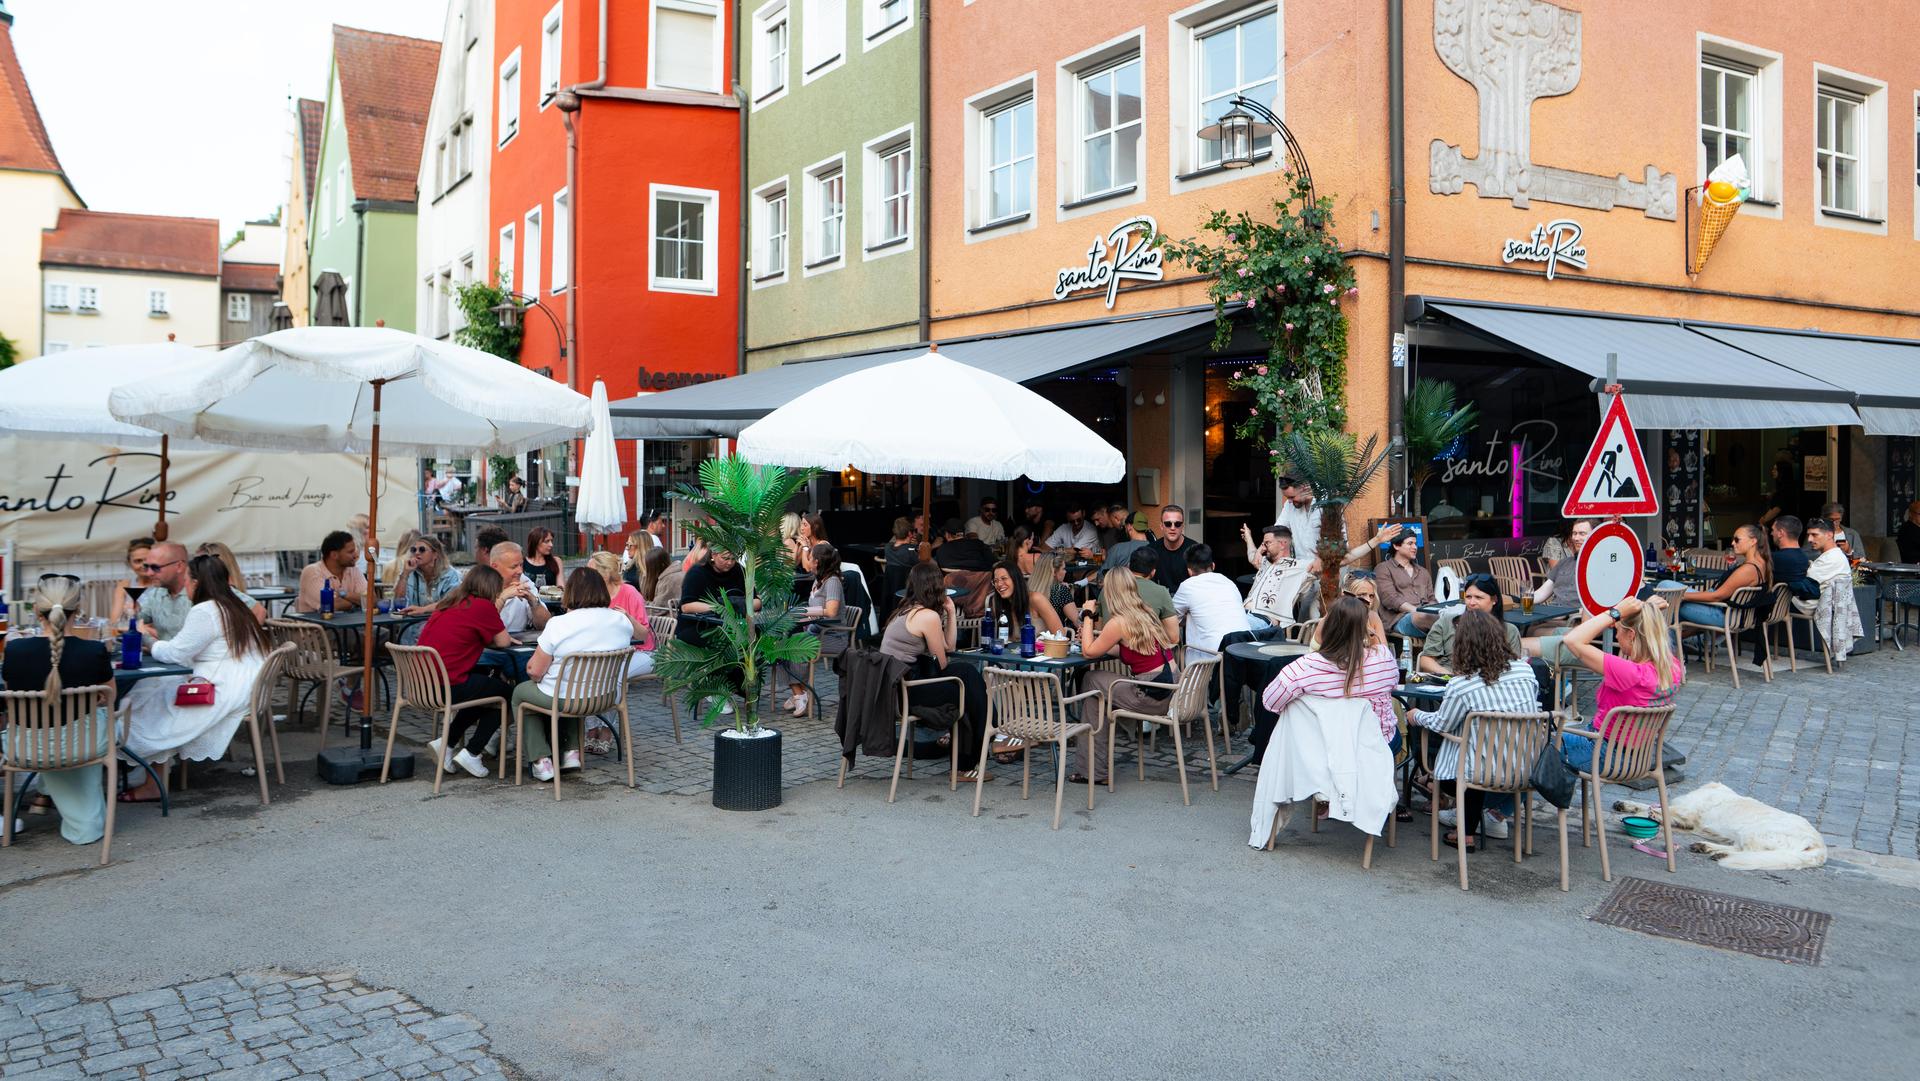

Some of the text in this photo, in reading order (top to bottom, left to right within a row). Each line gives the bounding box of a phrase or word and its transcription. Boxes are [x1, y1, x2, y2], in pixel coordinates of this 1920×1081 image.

[1056, 240, 1108, 294] santo
[1506, 227, 1550, 258] santo
[1441, 429, 1509, 483] santo
